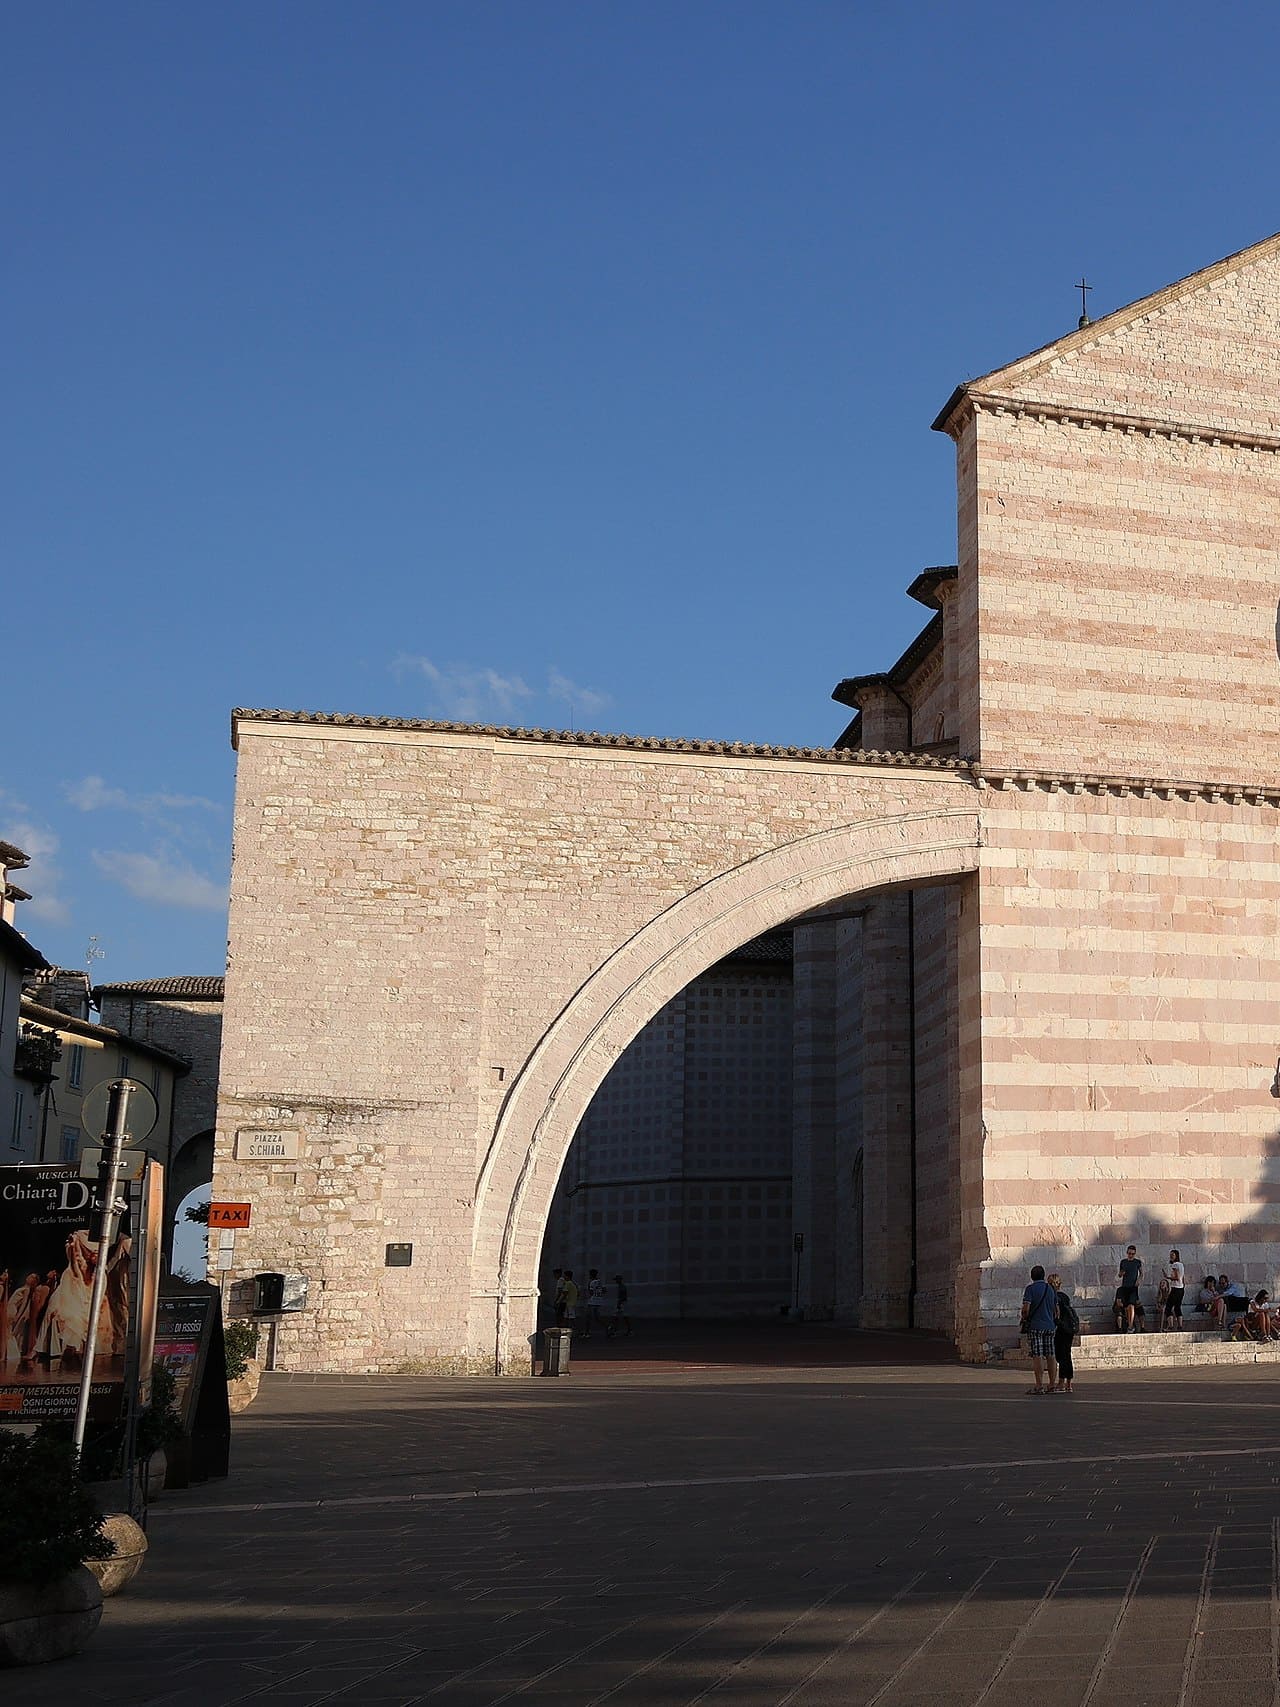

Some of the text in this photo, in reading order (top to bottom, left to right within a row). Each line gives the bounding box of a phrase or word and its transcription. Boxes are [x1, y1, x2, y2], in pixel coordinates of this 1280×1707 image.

[254, 1134, 282, 1142] PIAZZA
[249, 1144, 285, 1156] S.CHIARA
[36, 1171, 79, 1180] MUSICAL
[2, 1183, 57, 1200] Chiara
[46, 1201, 55, 1210] di
[212, 1210, 247, 1220] TAXI
[0, 1385, 112, 1396] EATRO METASTASIO ssisi
[22, 1399, 43, 1407] OGNI
[44, 1398, 77, 1406] GIORNO
[48, 1407, 62, 1415] per
